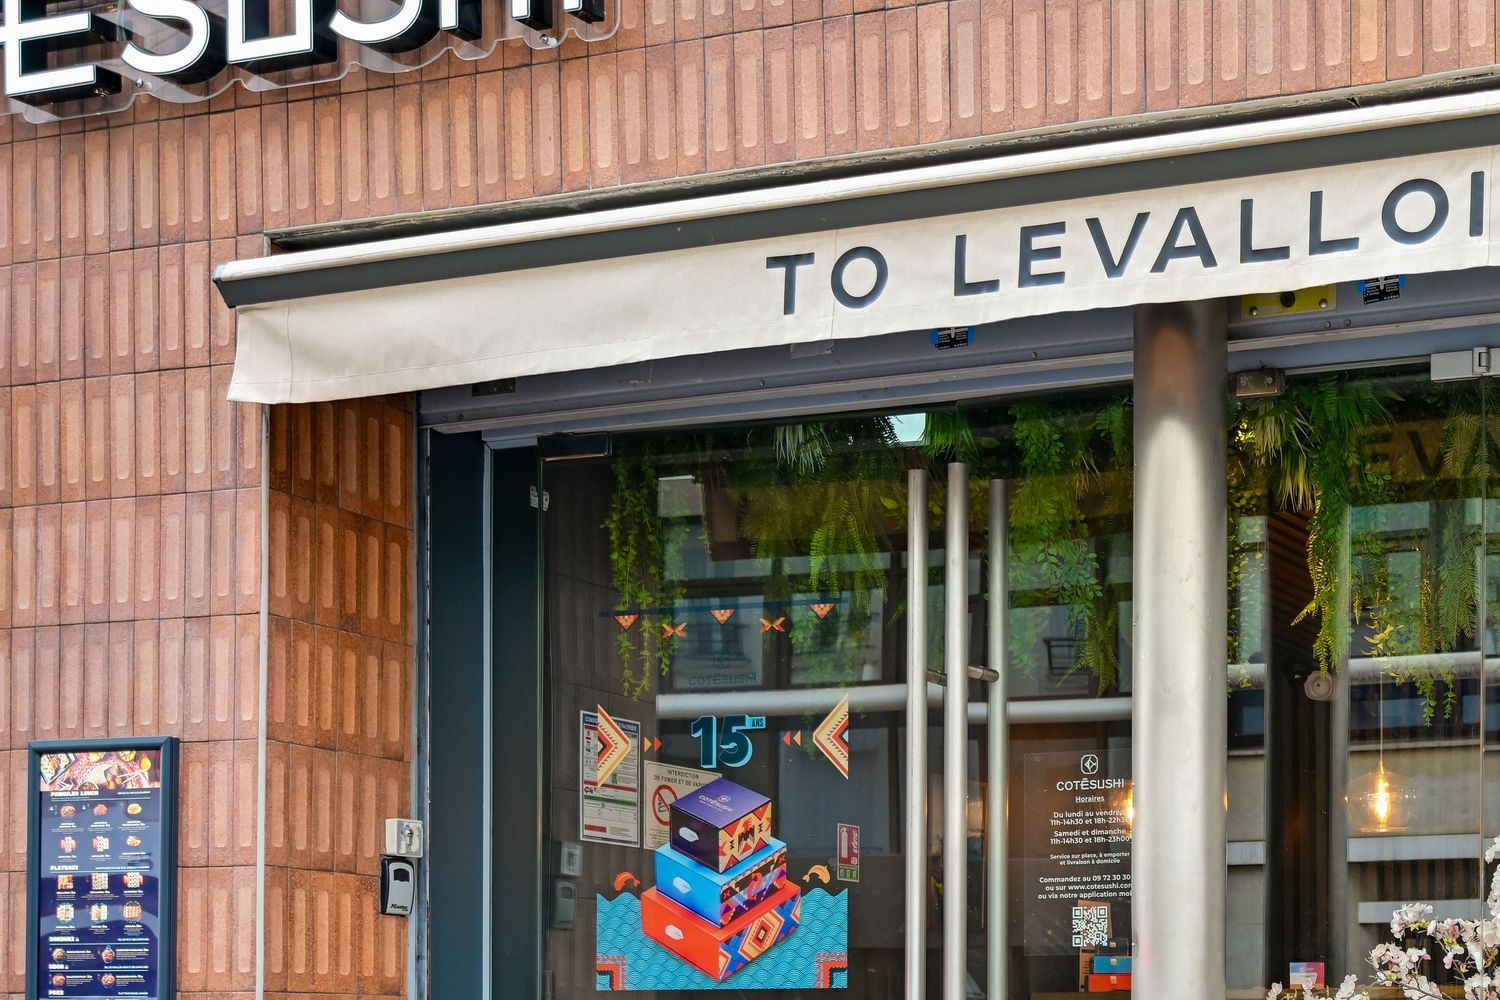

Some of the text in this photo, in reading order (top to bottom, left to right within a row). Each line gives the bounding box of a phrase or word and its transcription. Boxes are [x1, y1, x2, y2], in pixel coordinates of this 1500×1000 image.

[765, 249, 890, 317] TO
[751, 718, 764, 728] ANS
[691, 714, 753, 769] 15
[653, 774, 660, 782] DE
[662, 775, 678, 785] FUMER
[667, 769, 700, 780] INTERDICTION
[1075, 795, 1105, 804] Horaires
[1053, 811, 1064, 819] Du
[1065, 810, 1084, 818] lundi
[1050, 818, 1084, 826] 11h-14h30
[1085, 817, 1093, 825] et
[1054, 827, 1127, 838] Samedi et dimanche
[1050, 837, 1084, 845] 11h-14h30
[1085, 836, 1093, 844] et
[1050, 852, 1071, 860] Service
[1103, 850, 1130, 859] emporter
[1096, 857, 1121, 865] domicile
[1039, 873, 1131, 884] Commandez au 09 72 30 30
[1079, 889, 1118, 899] application
